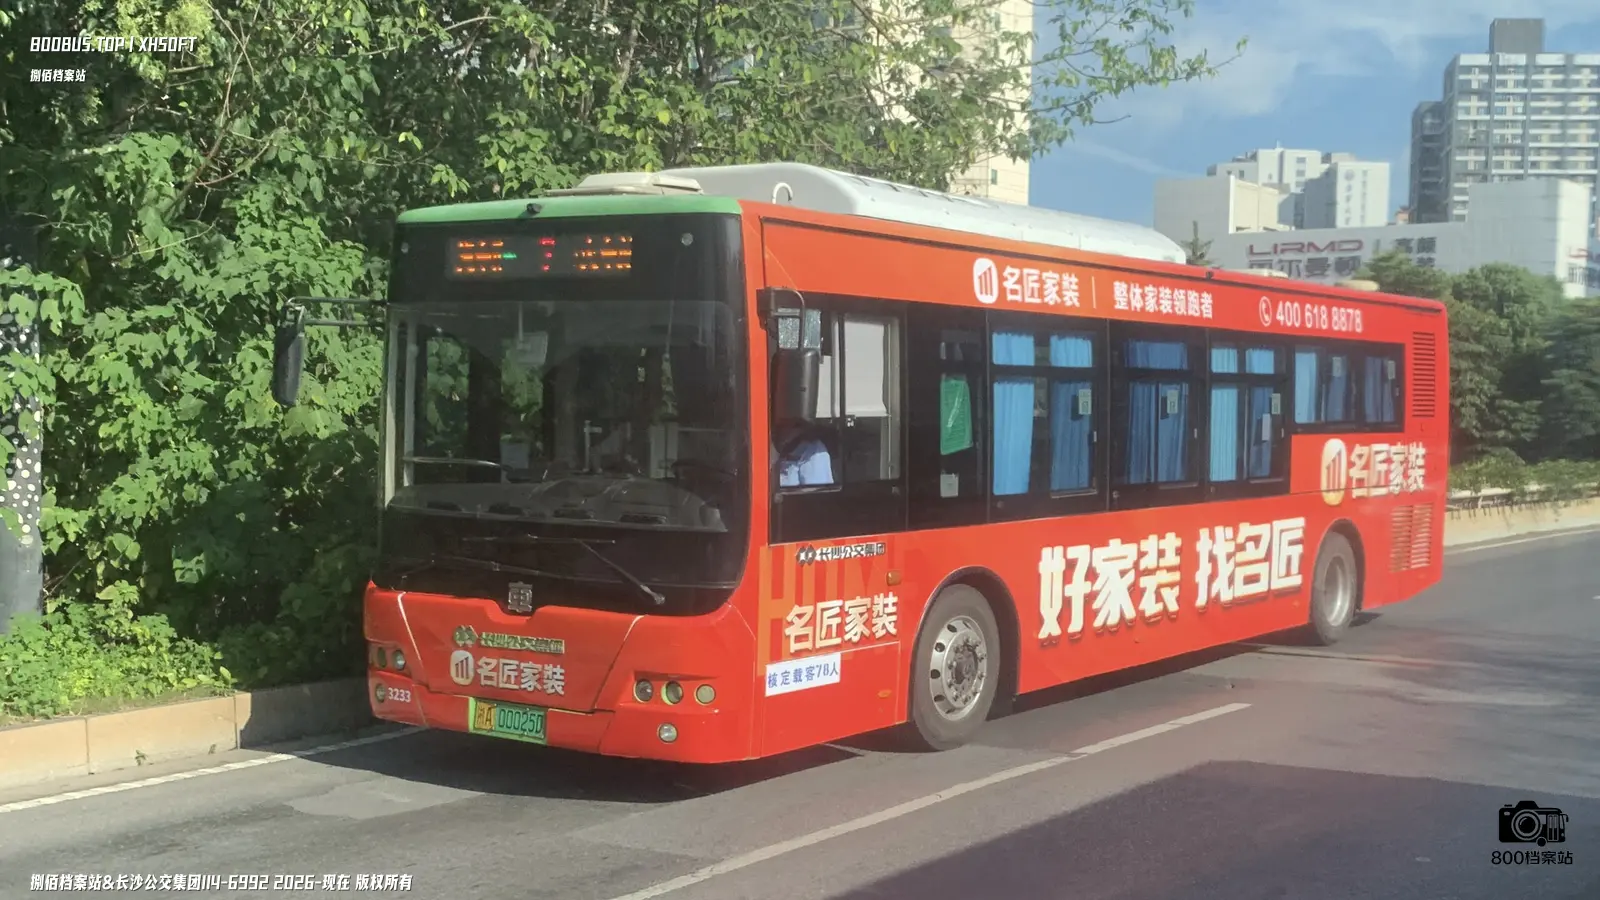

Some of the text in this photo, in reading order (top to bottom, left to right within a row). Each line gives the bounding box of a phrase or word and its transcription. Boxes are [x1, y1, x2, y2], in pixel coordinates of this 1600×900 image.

[1113, 280, 1213, 319] 整体家装领跑者
[1276, 301, 1364, 333] 400 618 8878
[1038, 517, 1306, 639] 好家装 找名匠
[767, 662, 839, 689] 核定载客78人
[388, 687, 411, 703] 3233
